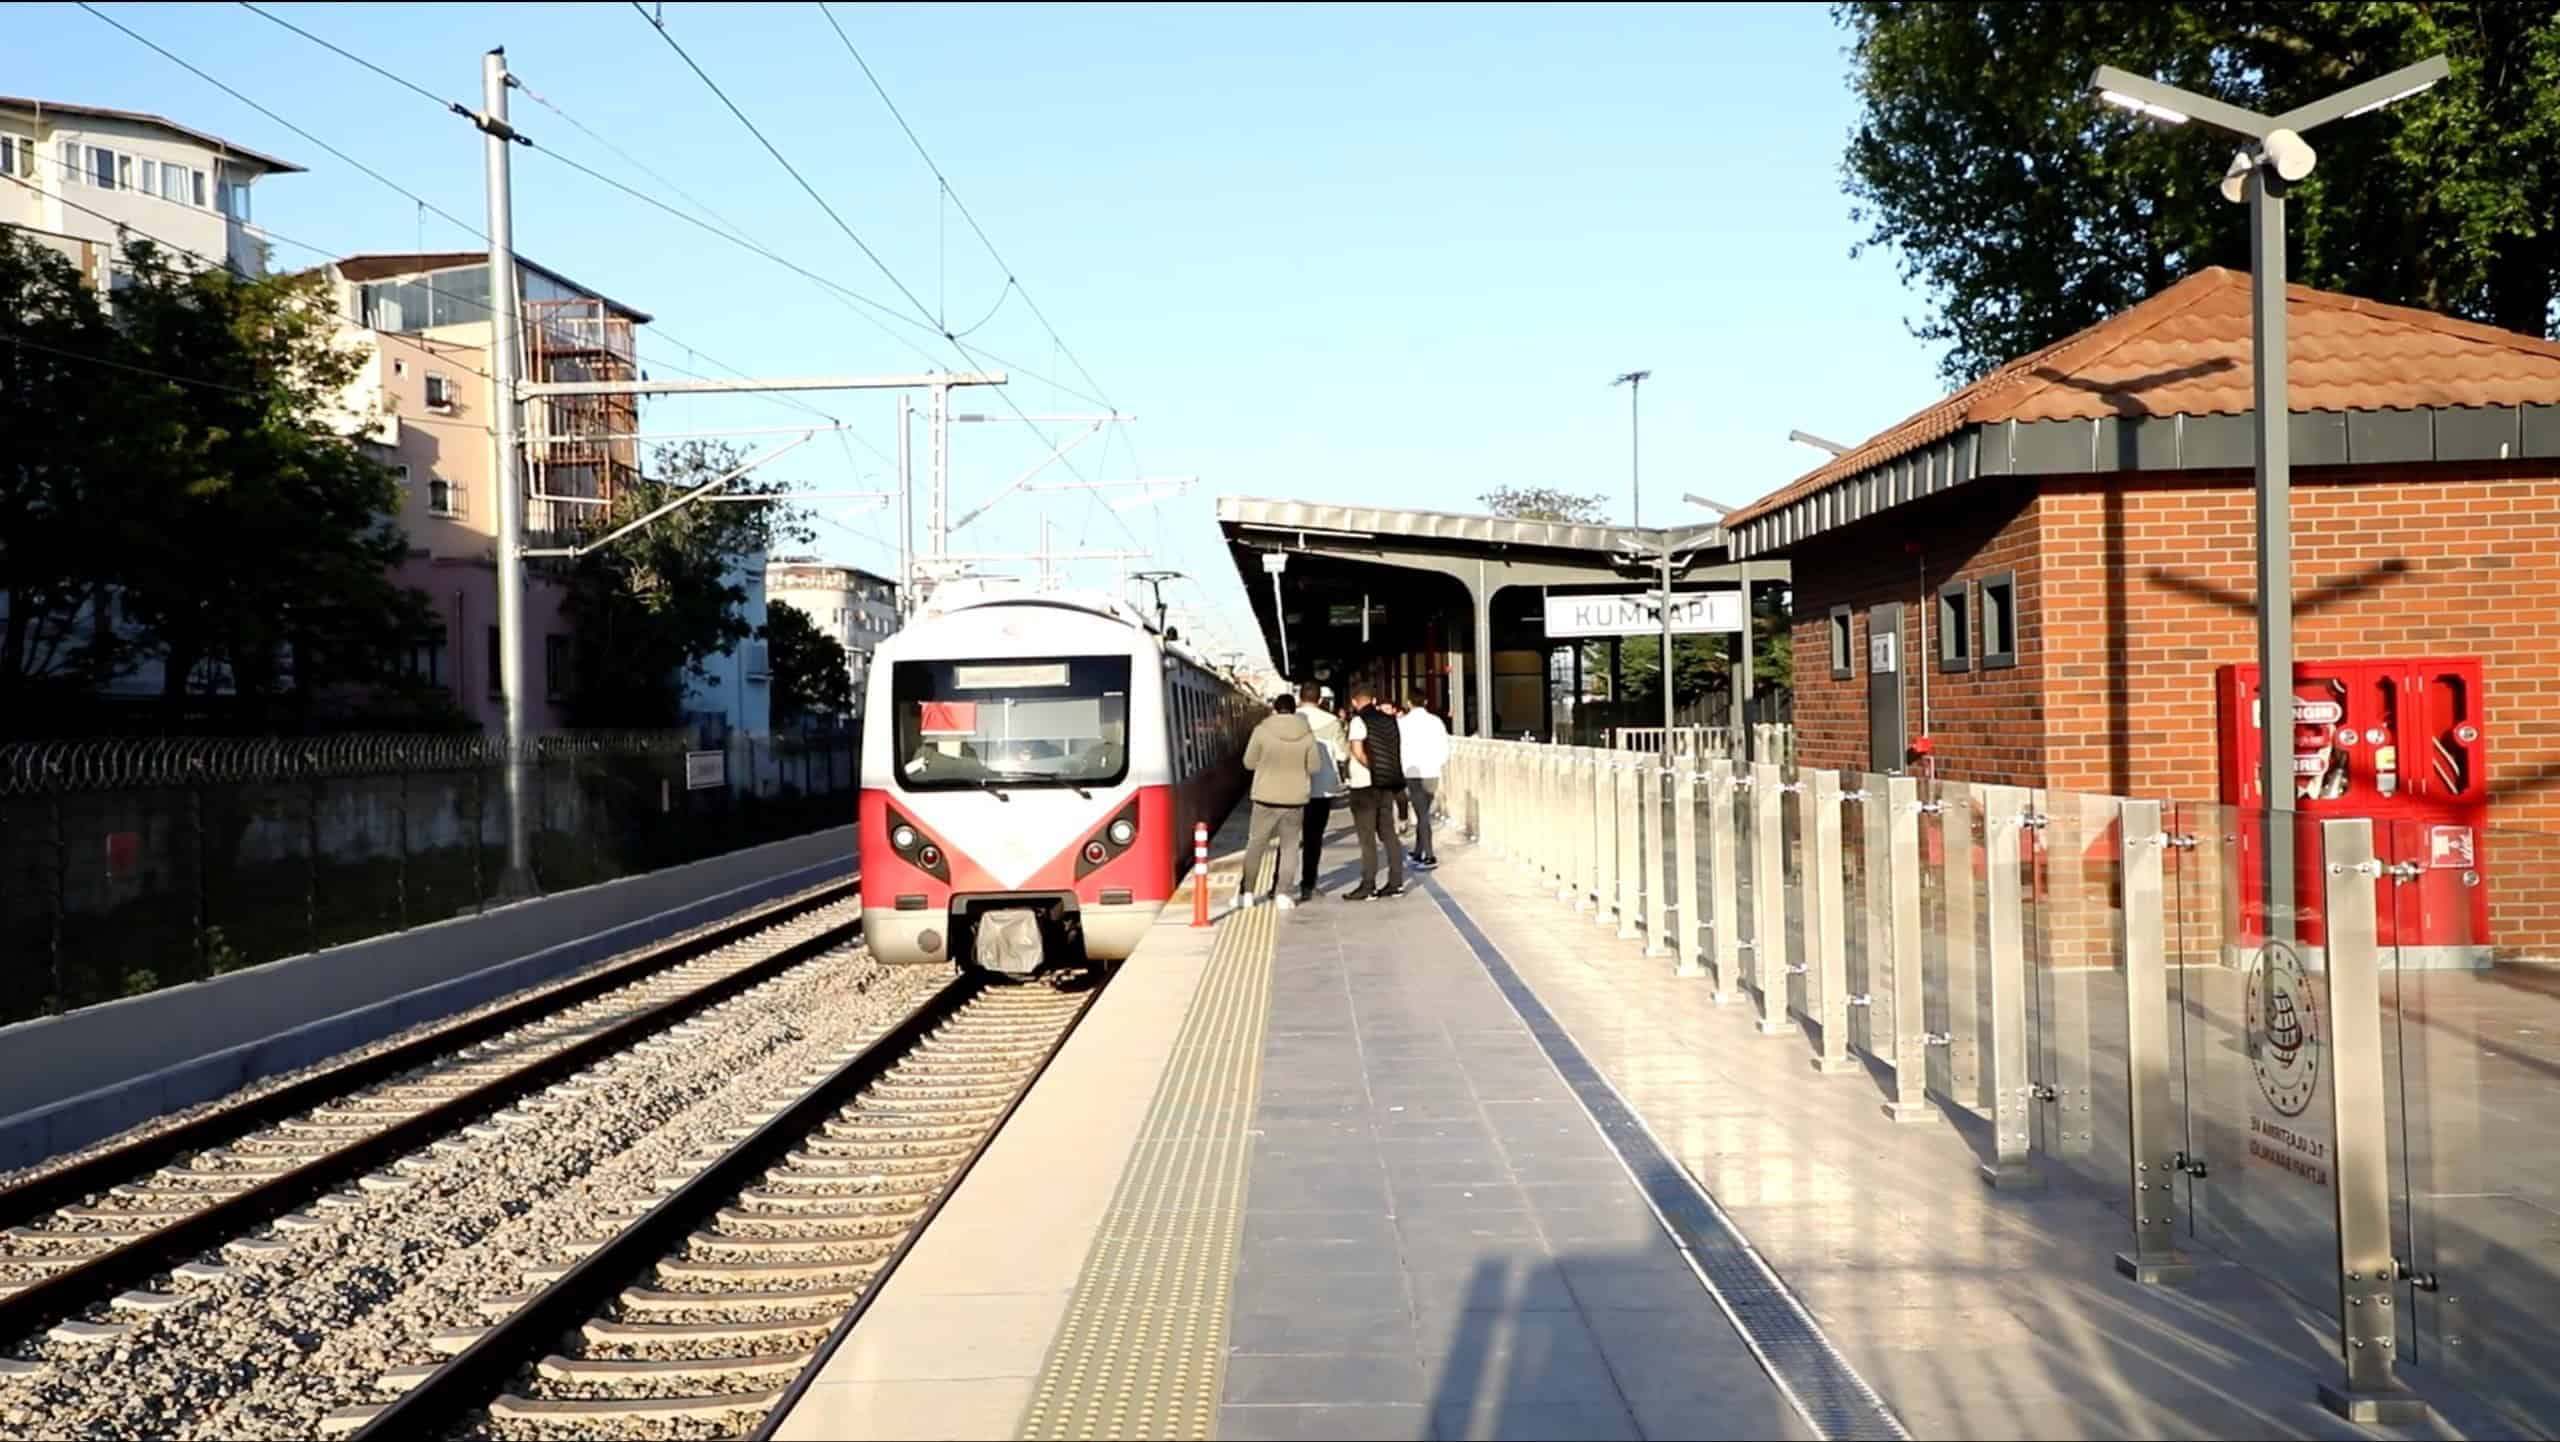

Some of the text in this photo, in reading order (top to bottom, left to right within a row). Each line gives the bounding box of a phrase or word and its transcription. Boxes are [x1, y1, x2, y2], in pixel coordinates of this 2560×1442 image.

[1575, 602, 1714, 626] KUMKAPI
[2292, 706, 2334, 720] NGIN
[2293, 759, 2321, 771] IRE
